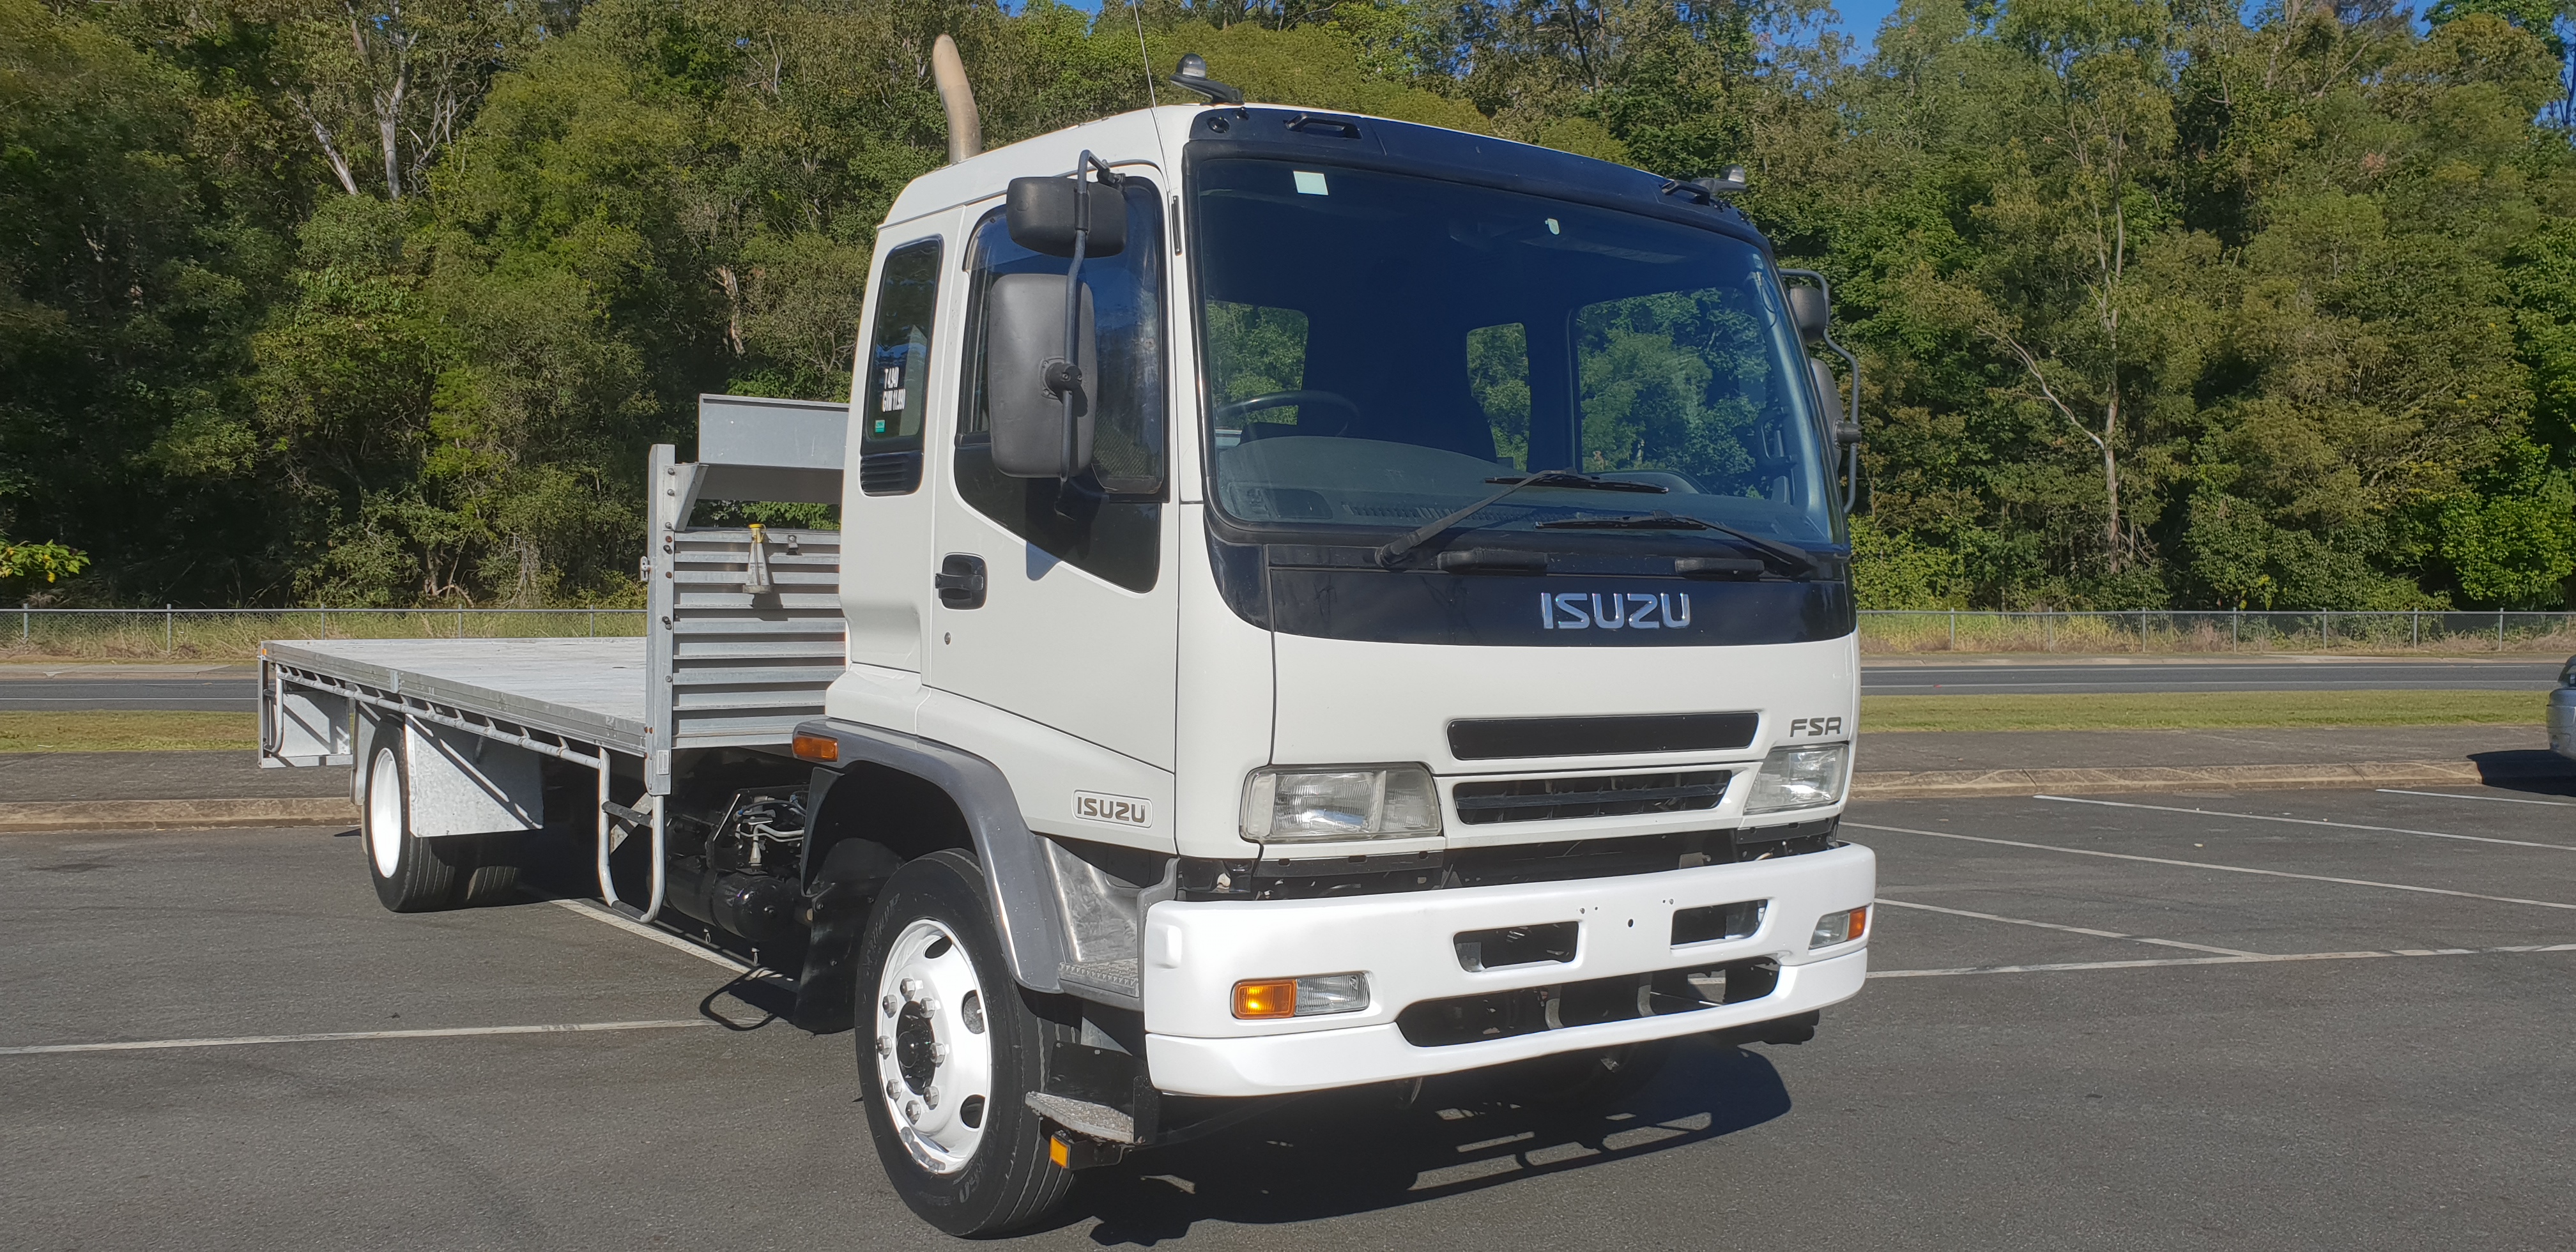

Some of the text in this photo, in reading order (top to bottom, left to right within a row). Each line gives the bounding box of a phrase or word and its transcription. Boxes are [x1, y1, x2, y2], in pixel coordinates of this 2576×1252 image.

[1540, 592, 1690, 630] ISUZU
[1790, 716, 1842, 738] FSR
[1077, 796, 1146, 823] ISUZU
